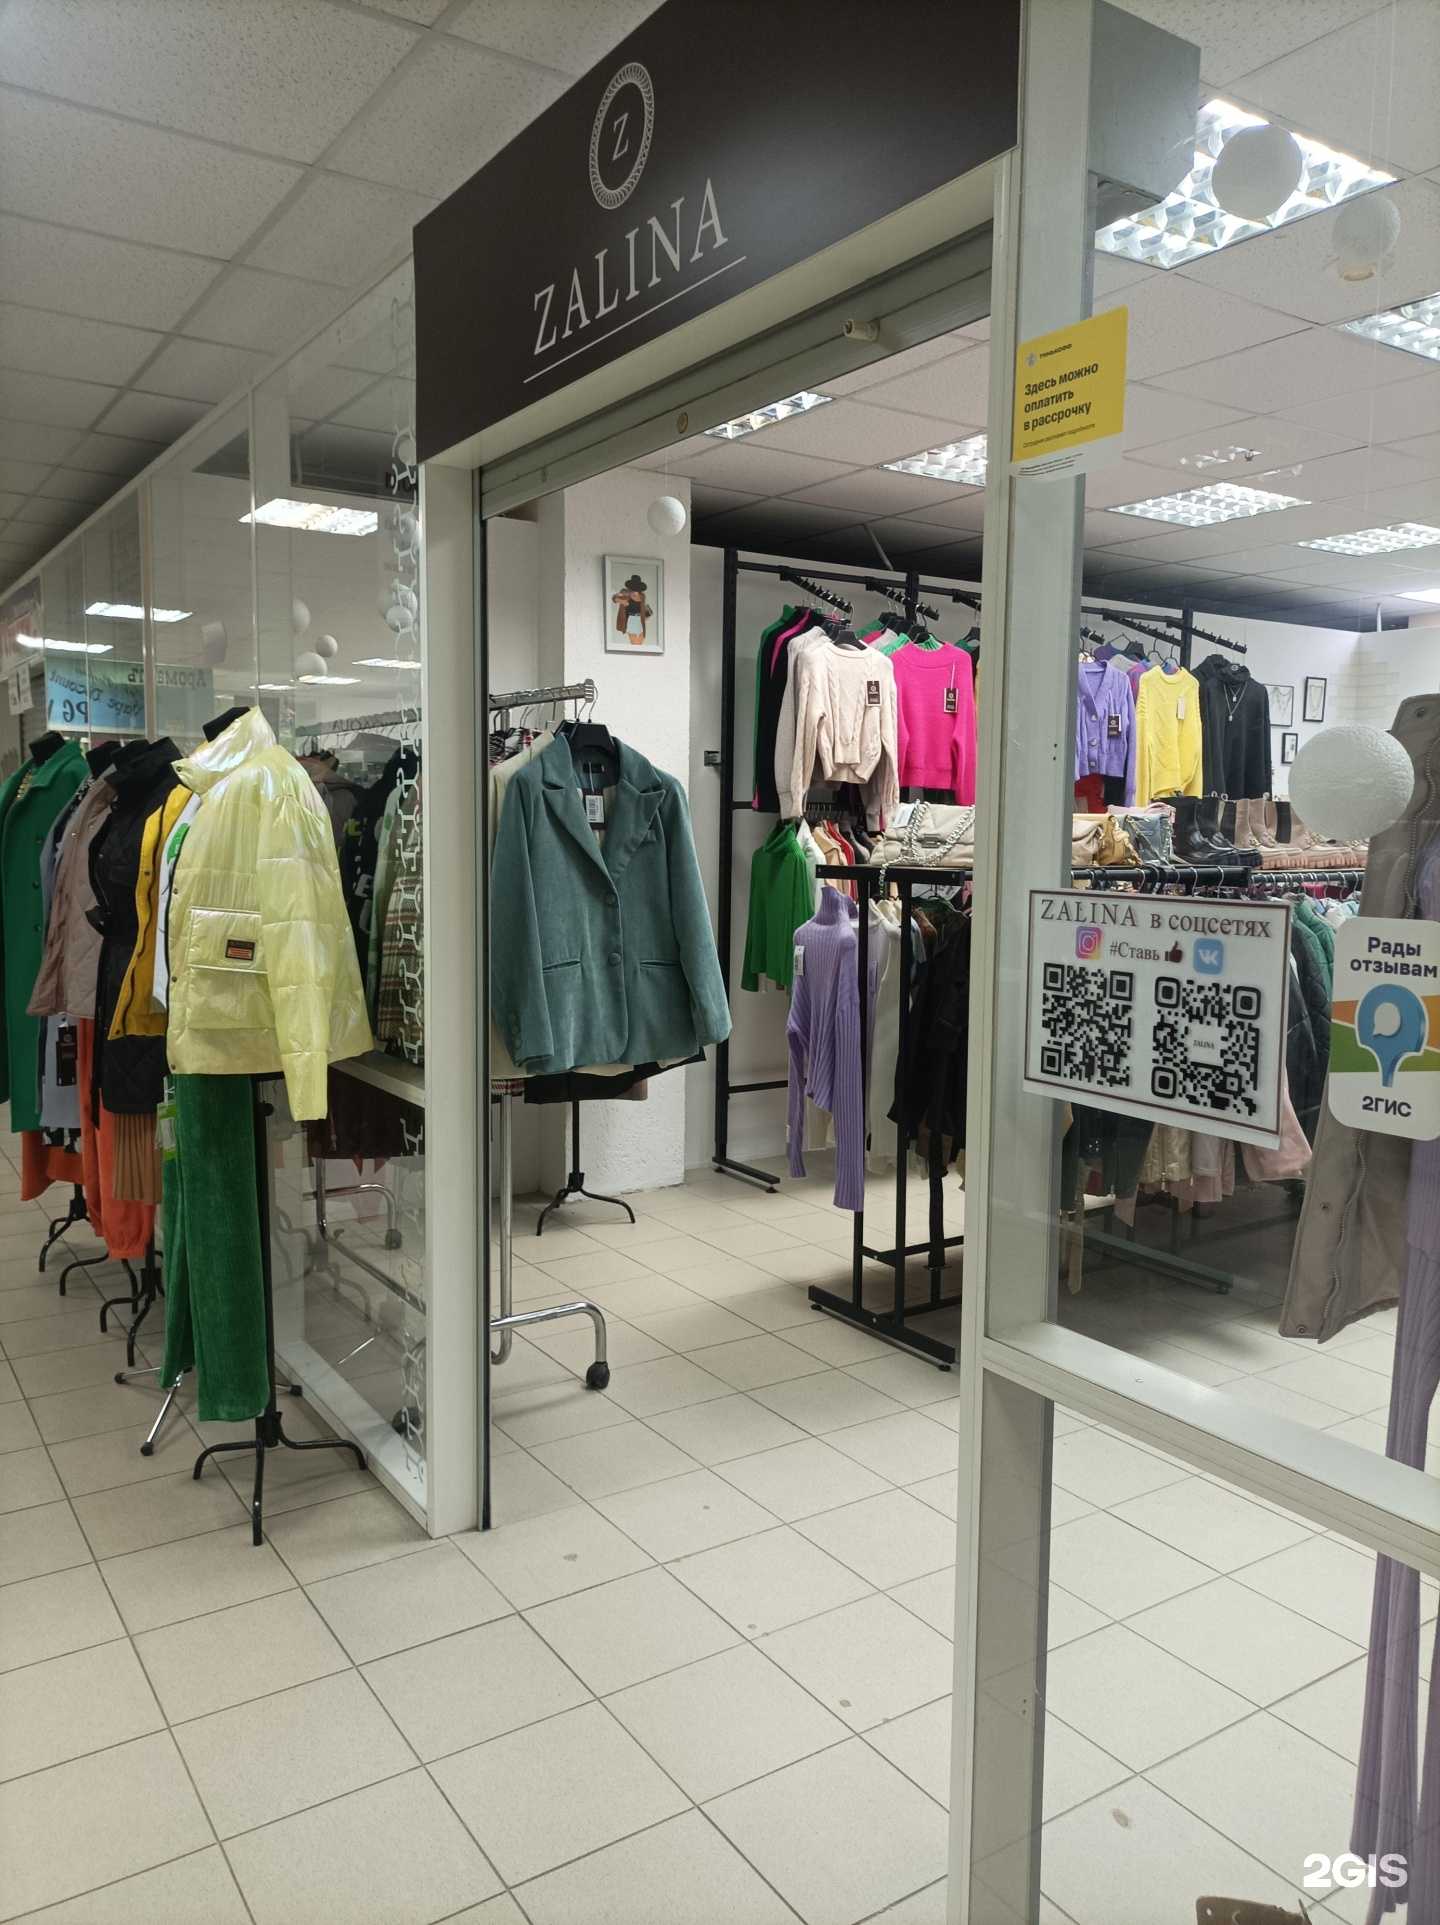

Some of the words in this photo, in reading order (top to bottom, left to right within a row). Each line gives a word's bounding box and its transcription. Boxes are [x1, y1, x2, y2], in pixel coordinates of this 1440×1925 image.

[612, 112, 629, 161] Z
[534, 177, 729, 356] ZALINA
[1024, 377, 1057, 396] Здесь
[1058, 362, 1099, 385] можно
[1024, 390, 1075, 414] оплатить
[1023, 420, 1031, 432] в
[1031, 401, 1092, 432] рассрочку
[1041, 899, 1137, 928] ZALINA
[1150, 913, 1162, 929] в
[1168, 914, 1272, 938] соцсетях
[1109, 941, 1160, 961] #Ставь
[1367, 936, 1421, 957] Рады
[1350, 958, 1438, 978] отзывам
[1362, 1095, 1413, 1118] 2ГИС
